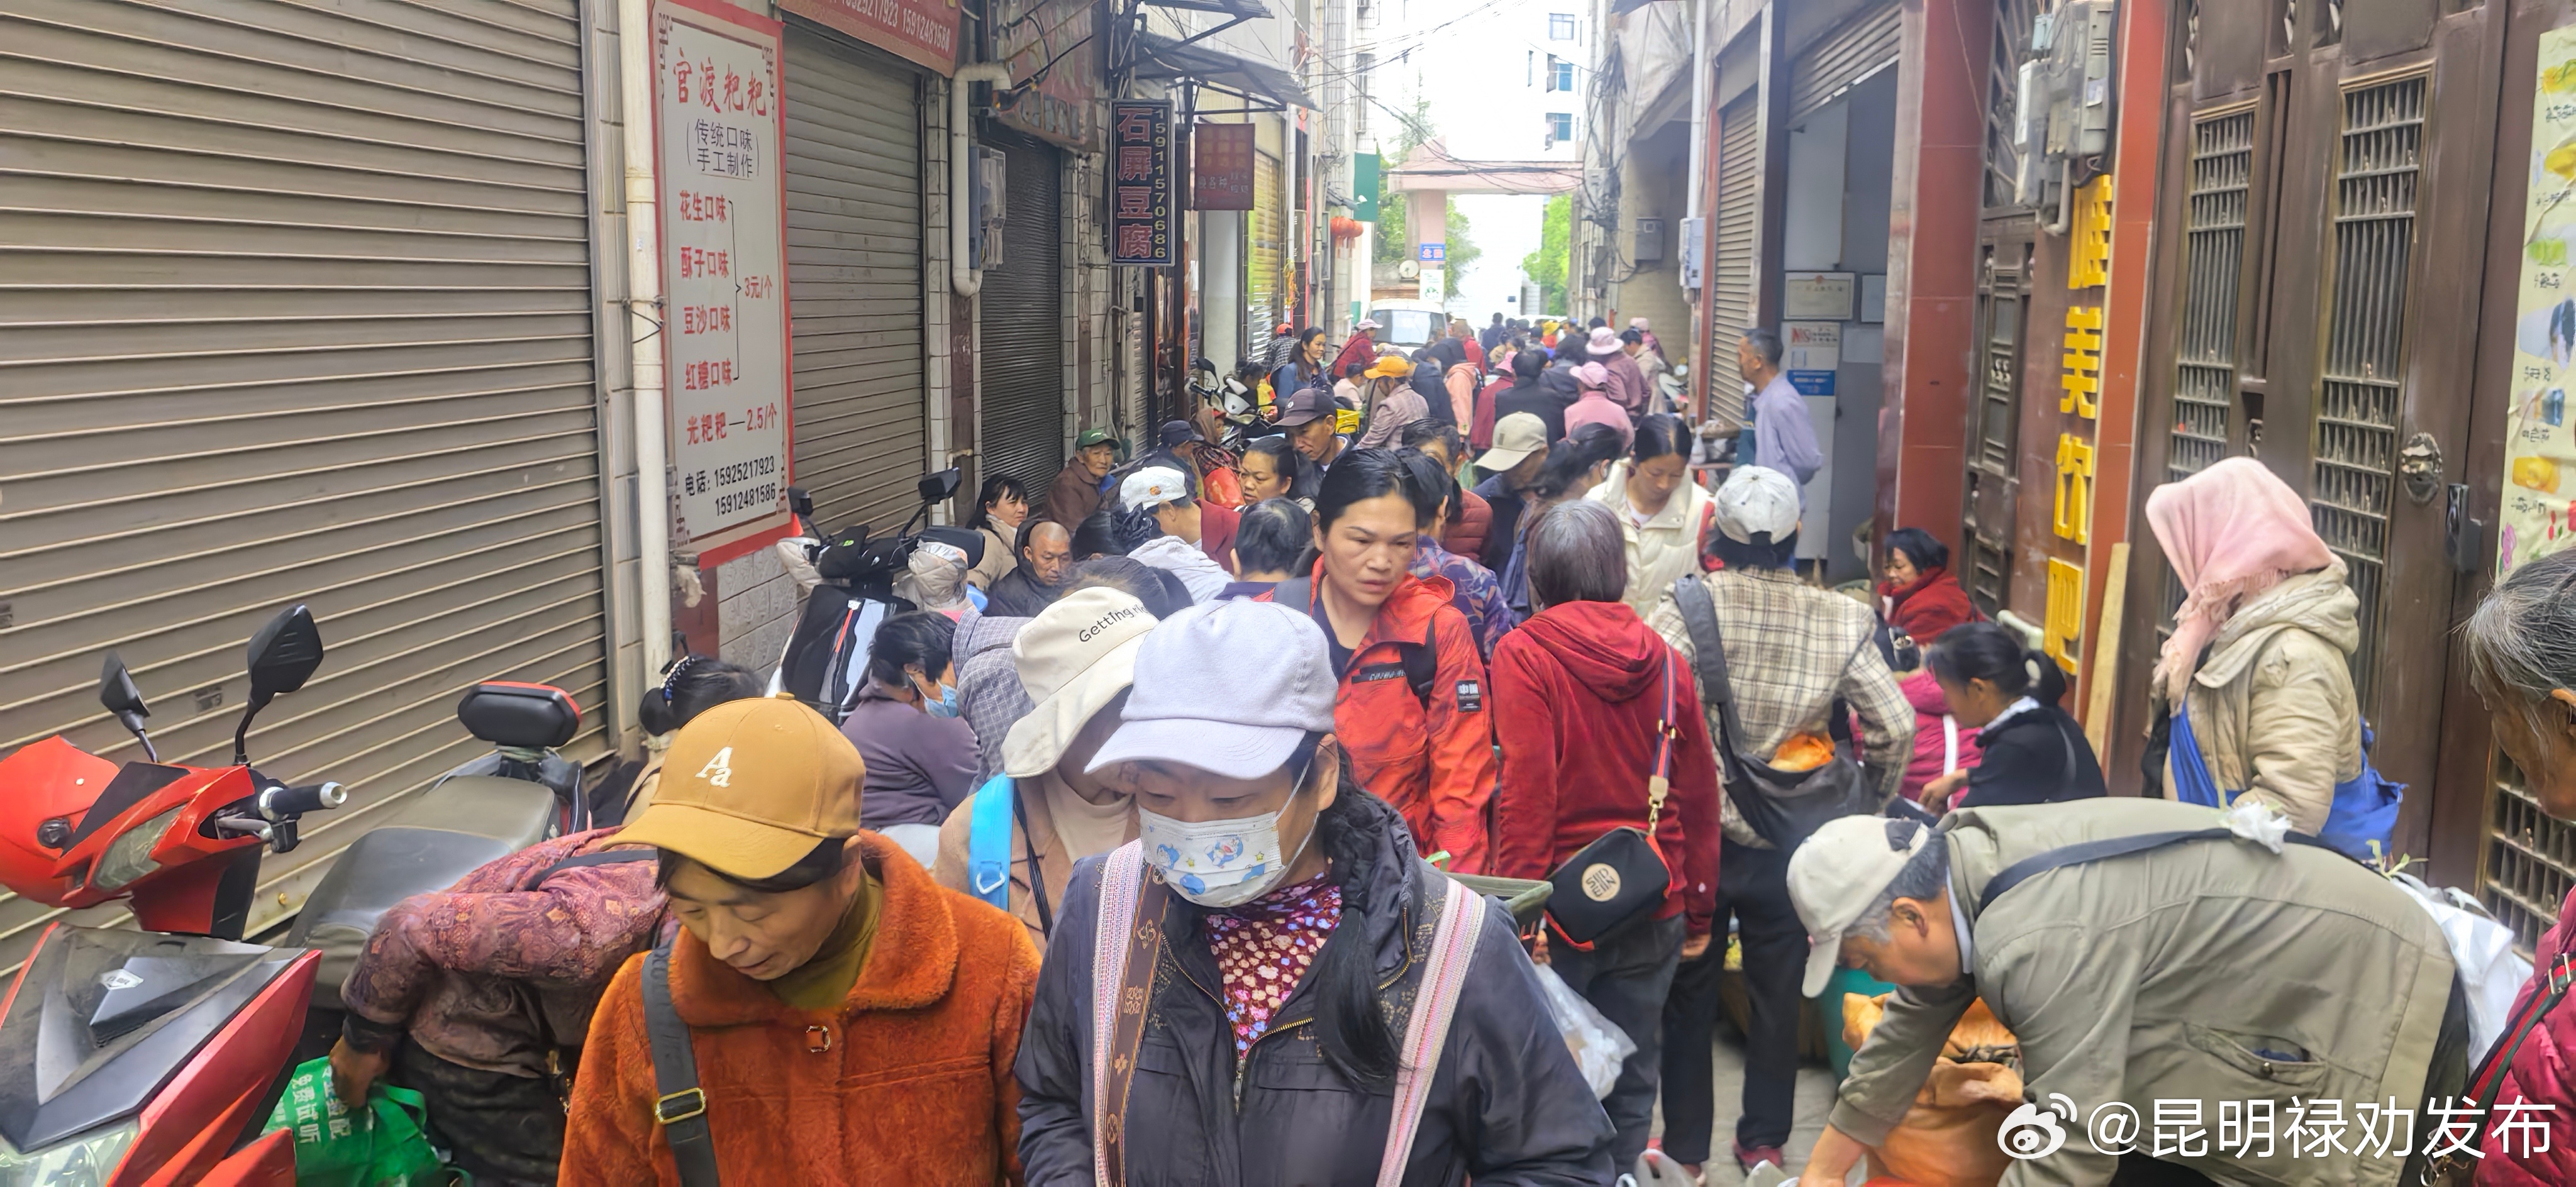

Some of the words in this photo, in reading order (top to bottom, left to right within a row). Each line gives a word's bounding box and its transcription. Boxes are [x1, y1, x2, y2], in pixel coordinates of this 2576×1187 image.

[674, 47, 766, 116] 官渡粑粑
[695, 118, 753, 152] 传统口味
[697, 148, 753, 178] 手工制作
[1117, 108, 1153, 258] 石屏豆腐
[1154, 109, 1167, 258] 15911570686
[680, 190, 726, 223] 花生口味
[745, 275, 773, 299] 3元/个
[684, 304, 730, 334] 豆沙口味
[686, 358, 732, 391] 红糖口味
[716, 483, 775, 516] 15912481586
[1079, 607, 1135, 643] Getting
